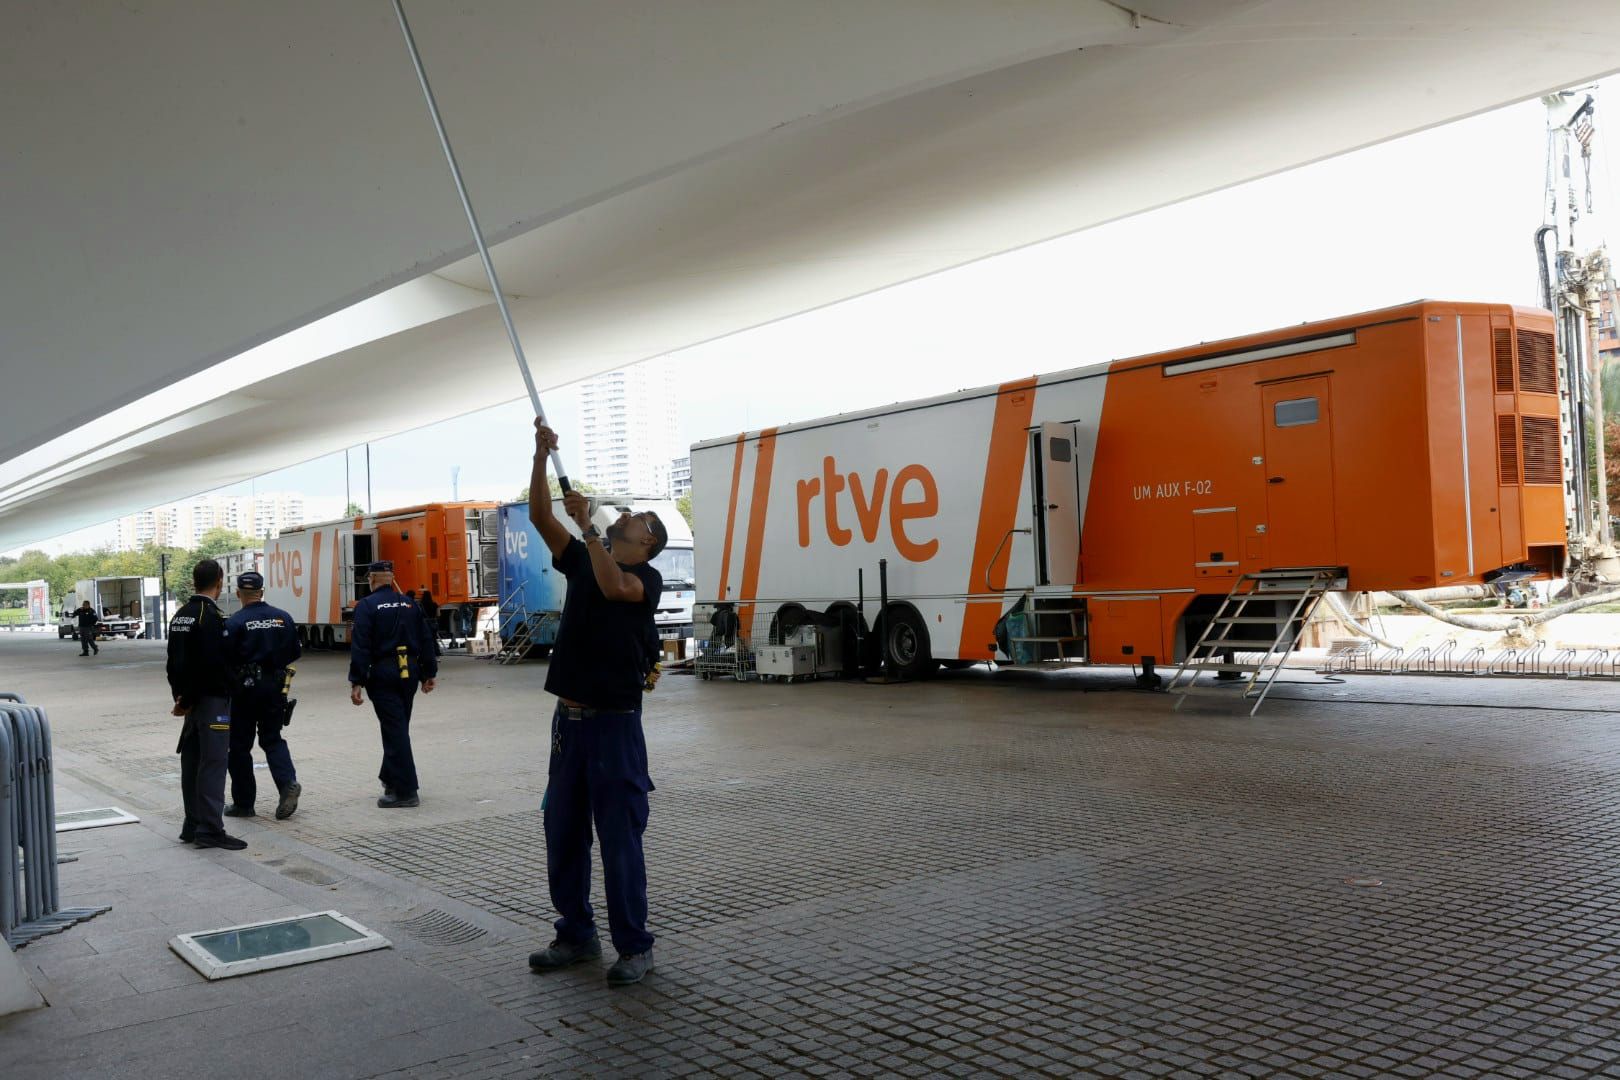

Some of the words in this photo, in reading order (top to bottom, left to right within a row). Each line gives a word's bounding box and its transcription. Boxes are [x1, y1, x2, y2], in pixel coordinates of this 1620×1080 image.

[797, 456, 939, 562] rtve
[1133, 486, 1151, 500] UM
[1156, 482, 1180, 498] AUX
[1185, 480, 1211, 496] F-02
[505, 526, 528, 559] tve
[269, 543, 303, 597] rtve
